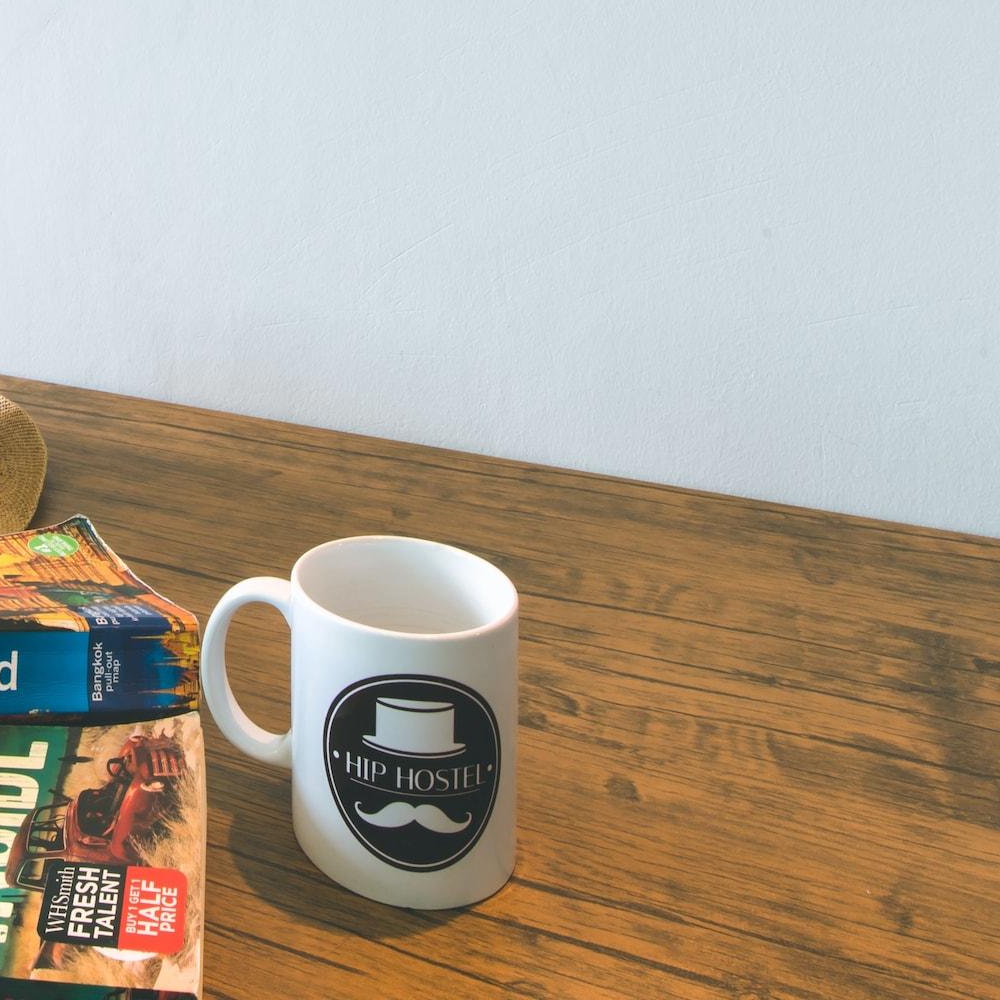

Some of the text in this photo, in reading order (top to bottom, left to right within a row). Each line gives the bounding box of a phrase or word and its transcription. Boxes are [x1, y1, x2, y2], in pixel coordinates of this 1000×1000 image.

[91, 642, 104, 702] Bangkok
[105, 651, 114, 692] pull-out
[113, 659, 121, 683] map
[345, 751, 487, 792] HIP HOSTEL
[45, 865, 77, 934] WHSmith
[68, 867, 102, 939] FRESH
[94, 869, 121, 939] TALENT
[128, 884, 140, 905] GET
[137, 880, 162, 937] HALF
[160, 887, 178, 933] PRICE
[125, 914, 137, 934] BUY
